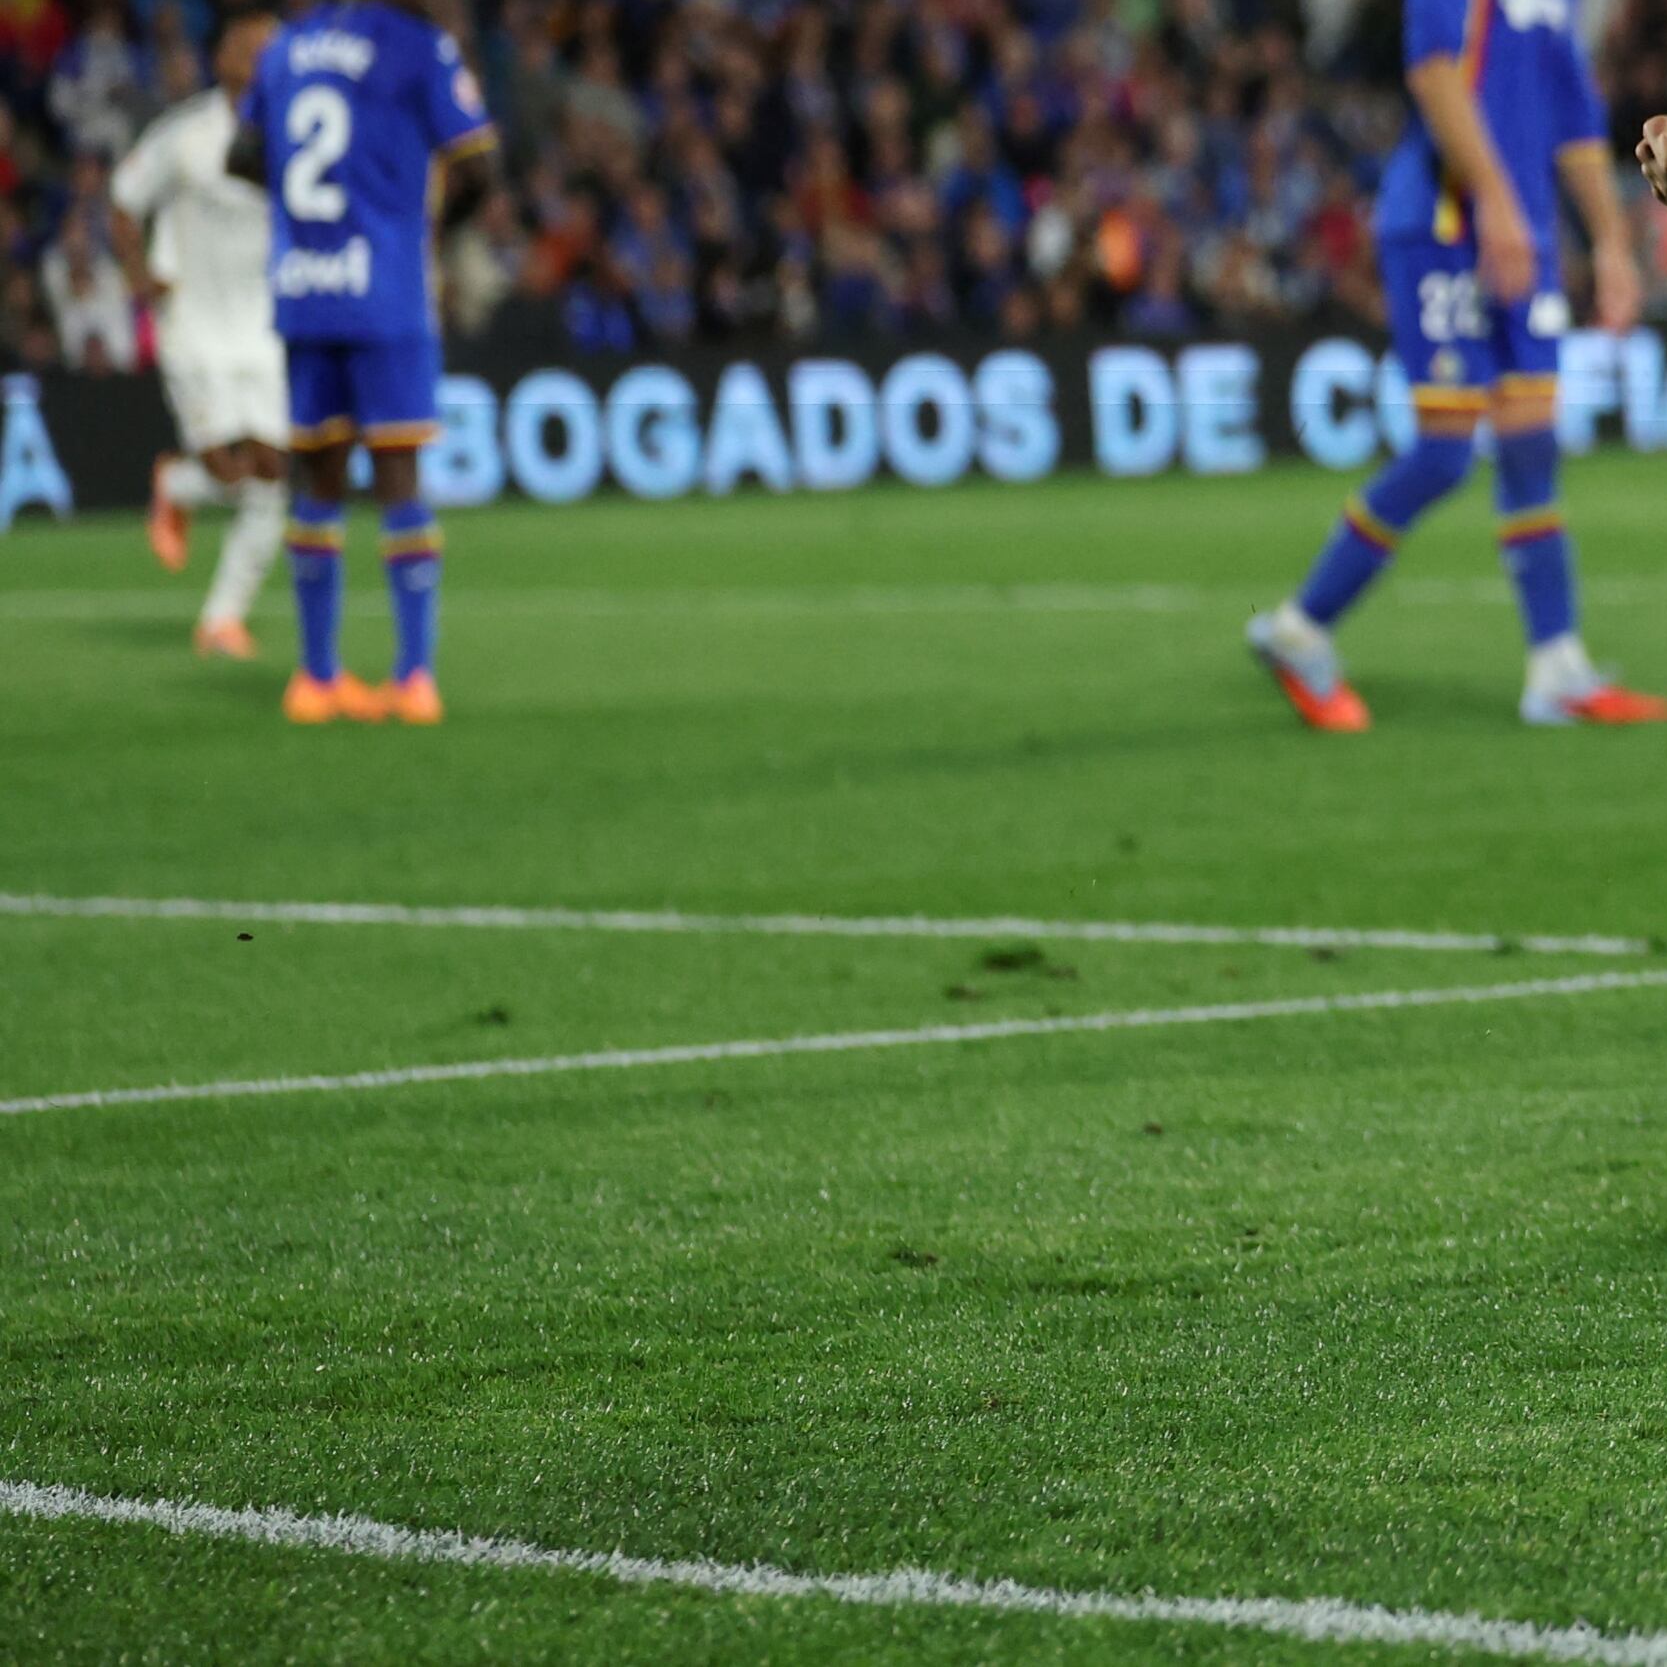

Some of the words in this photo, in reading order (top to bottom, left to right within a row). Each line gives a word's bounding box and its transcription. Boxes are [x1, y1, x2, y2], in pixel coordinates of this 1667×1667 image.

[283, 84, 351, 223] 2
[348, 348, 1062, 506] BOGADOS
[1090, 342, 1265, 476] DE
